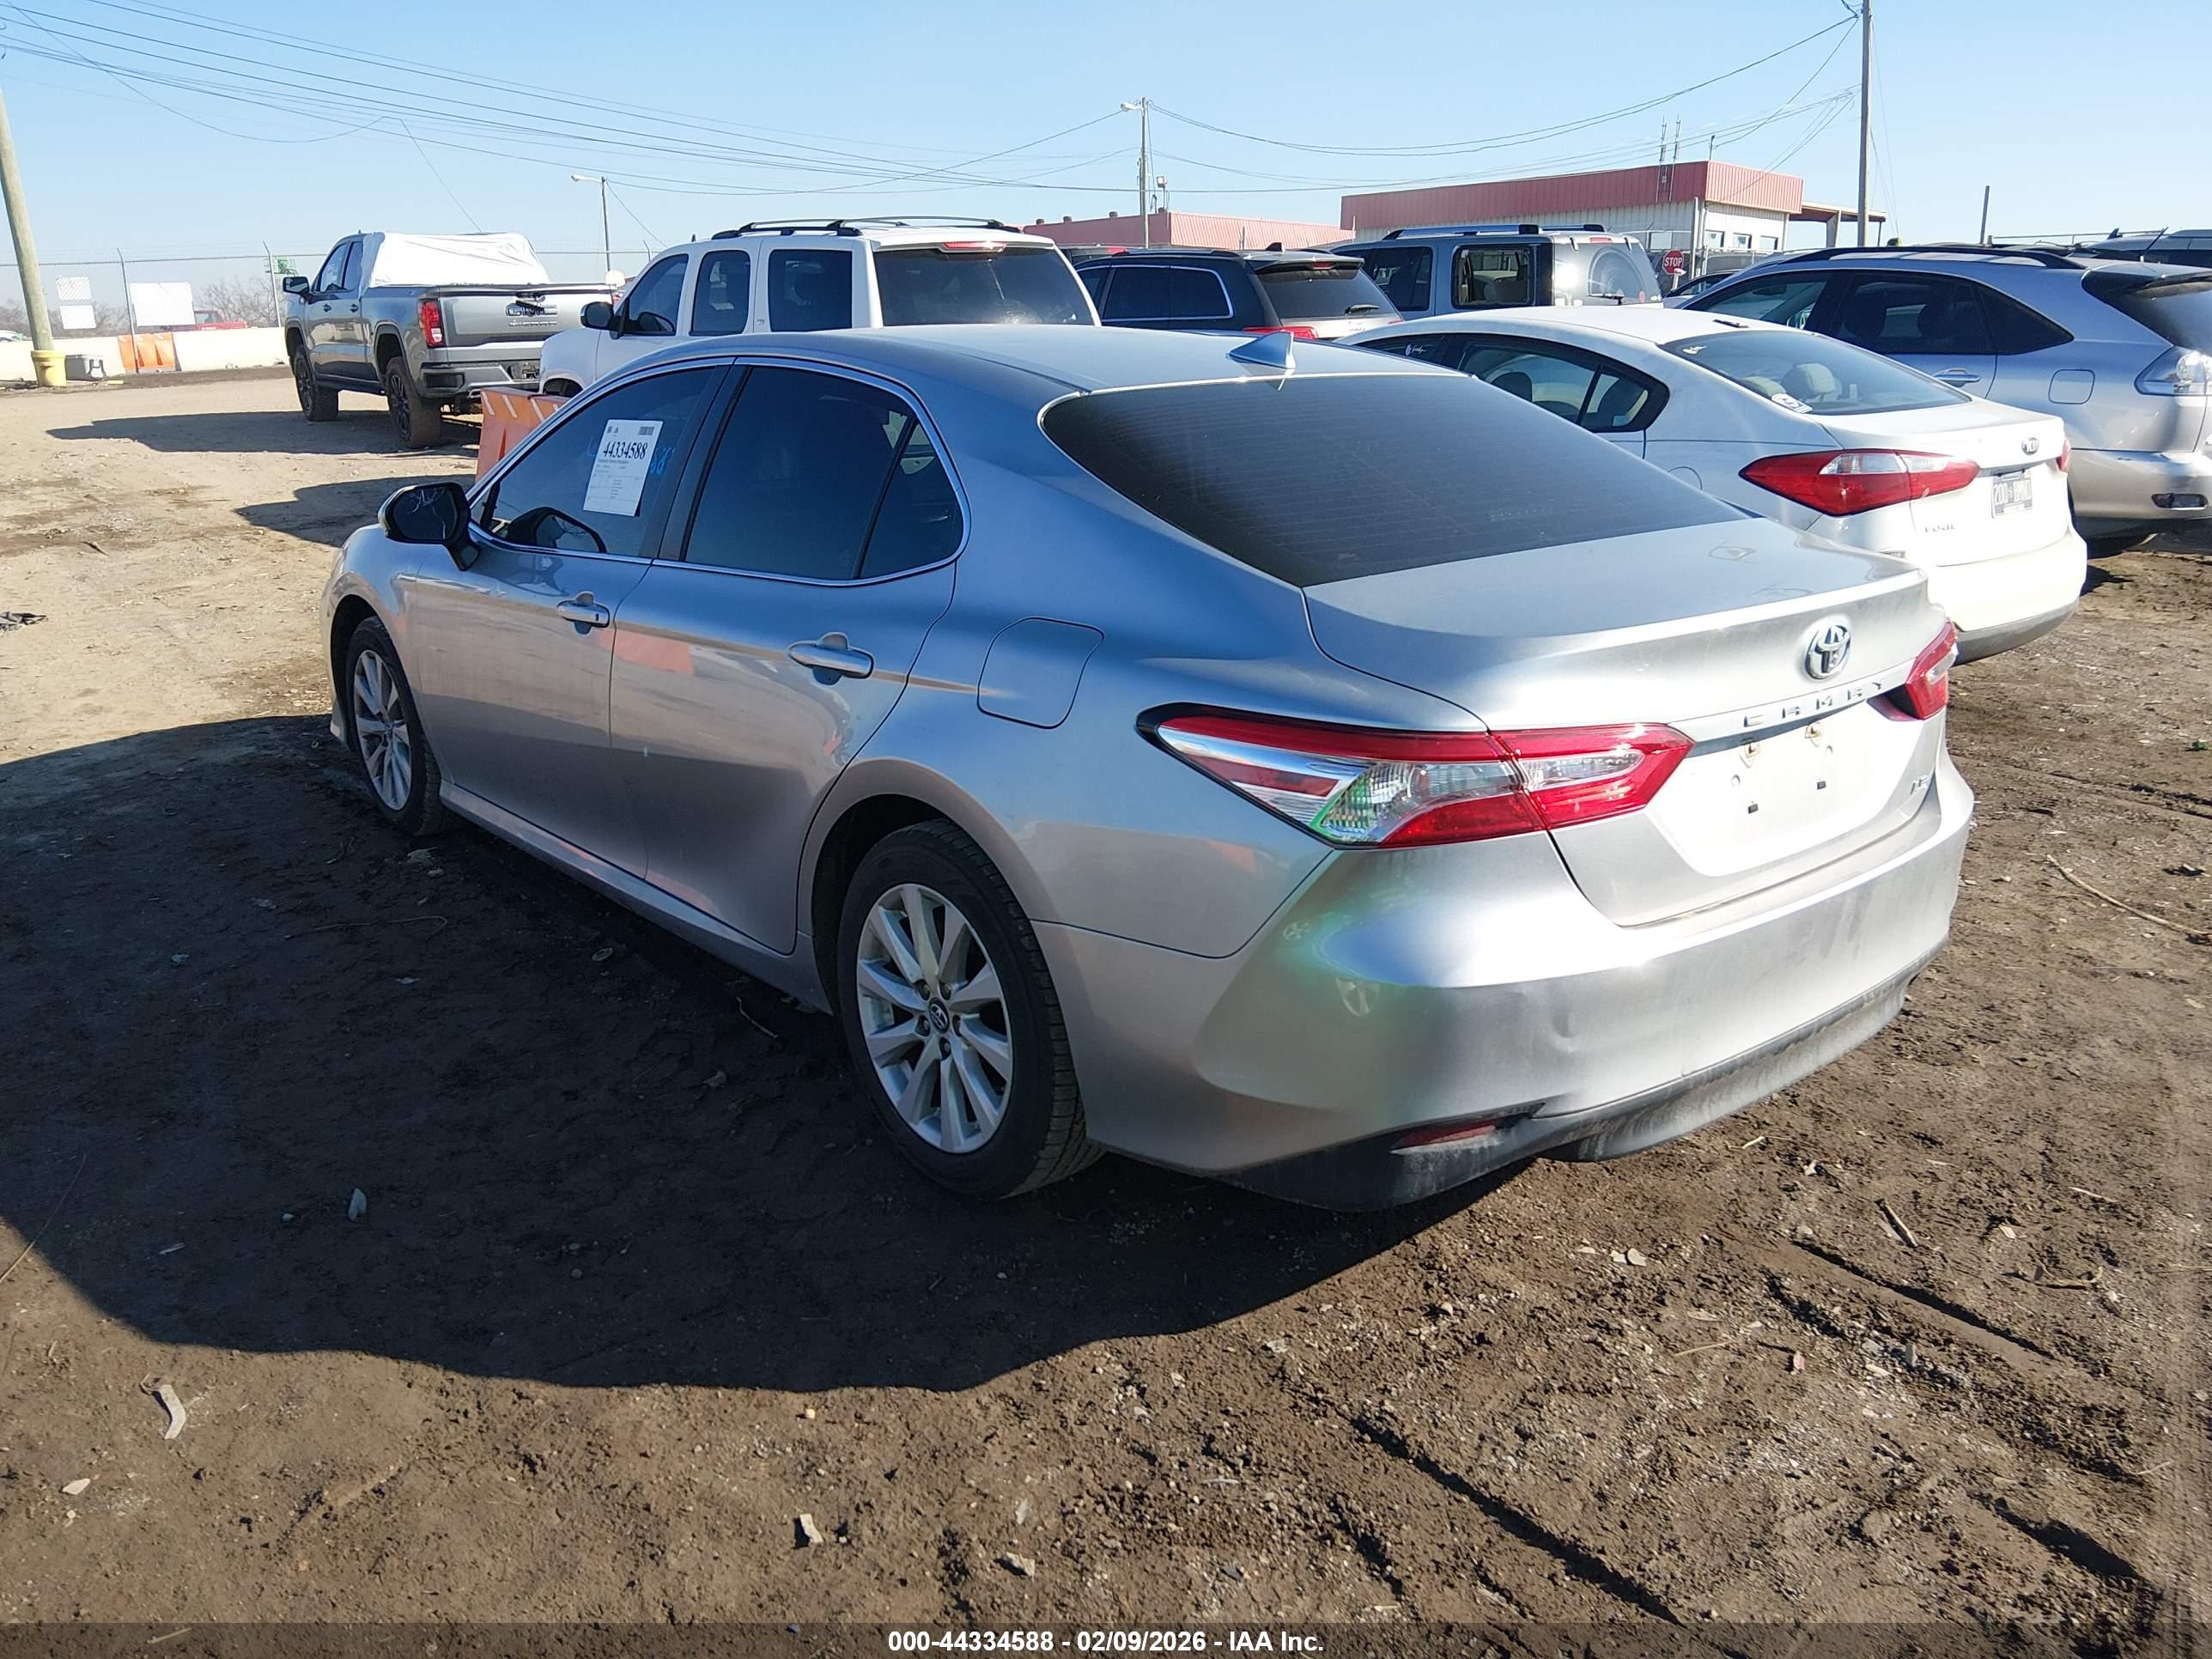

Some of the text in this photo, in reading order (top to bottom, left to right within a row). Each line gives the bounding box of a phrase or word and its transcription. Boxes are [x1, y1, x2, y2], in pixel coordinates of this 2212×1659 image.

[1664, 257, 1683, 267] STOP
[603, 441, 648, 459] 44334588
[1743, 680, 1884, 728] CAMRY
